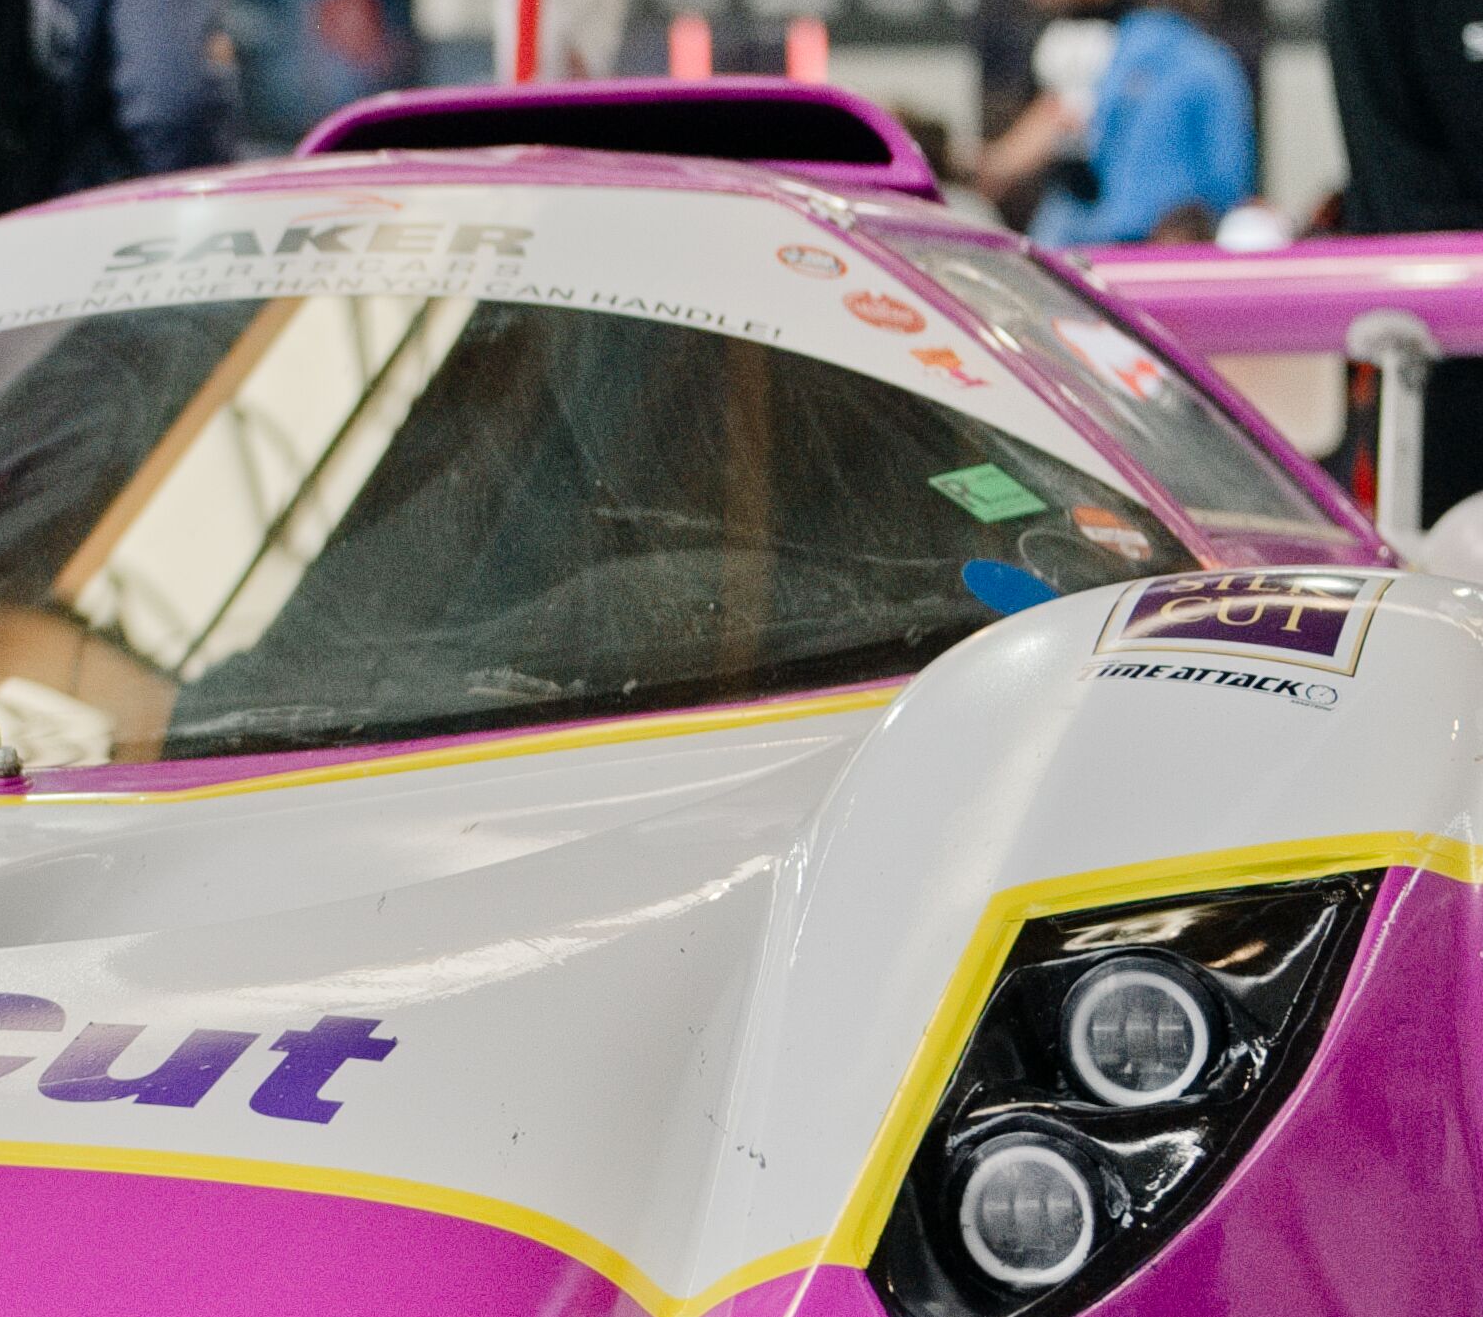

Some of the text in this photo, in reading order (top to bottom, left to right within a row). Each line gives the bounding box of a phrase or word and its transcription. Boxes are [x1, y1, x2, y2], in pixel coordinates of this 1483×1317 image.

[103, 222, 535, 273] SAKER
[483, 281, 576, 302] CAN
[589, 290, 784, 341] HANDLE!
[1160, 596, 1325, 632] CUT
